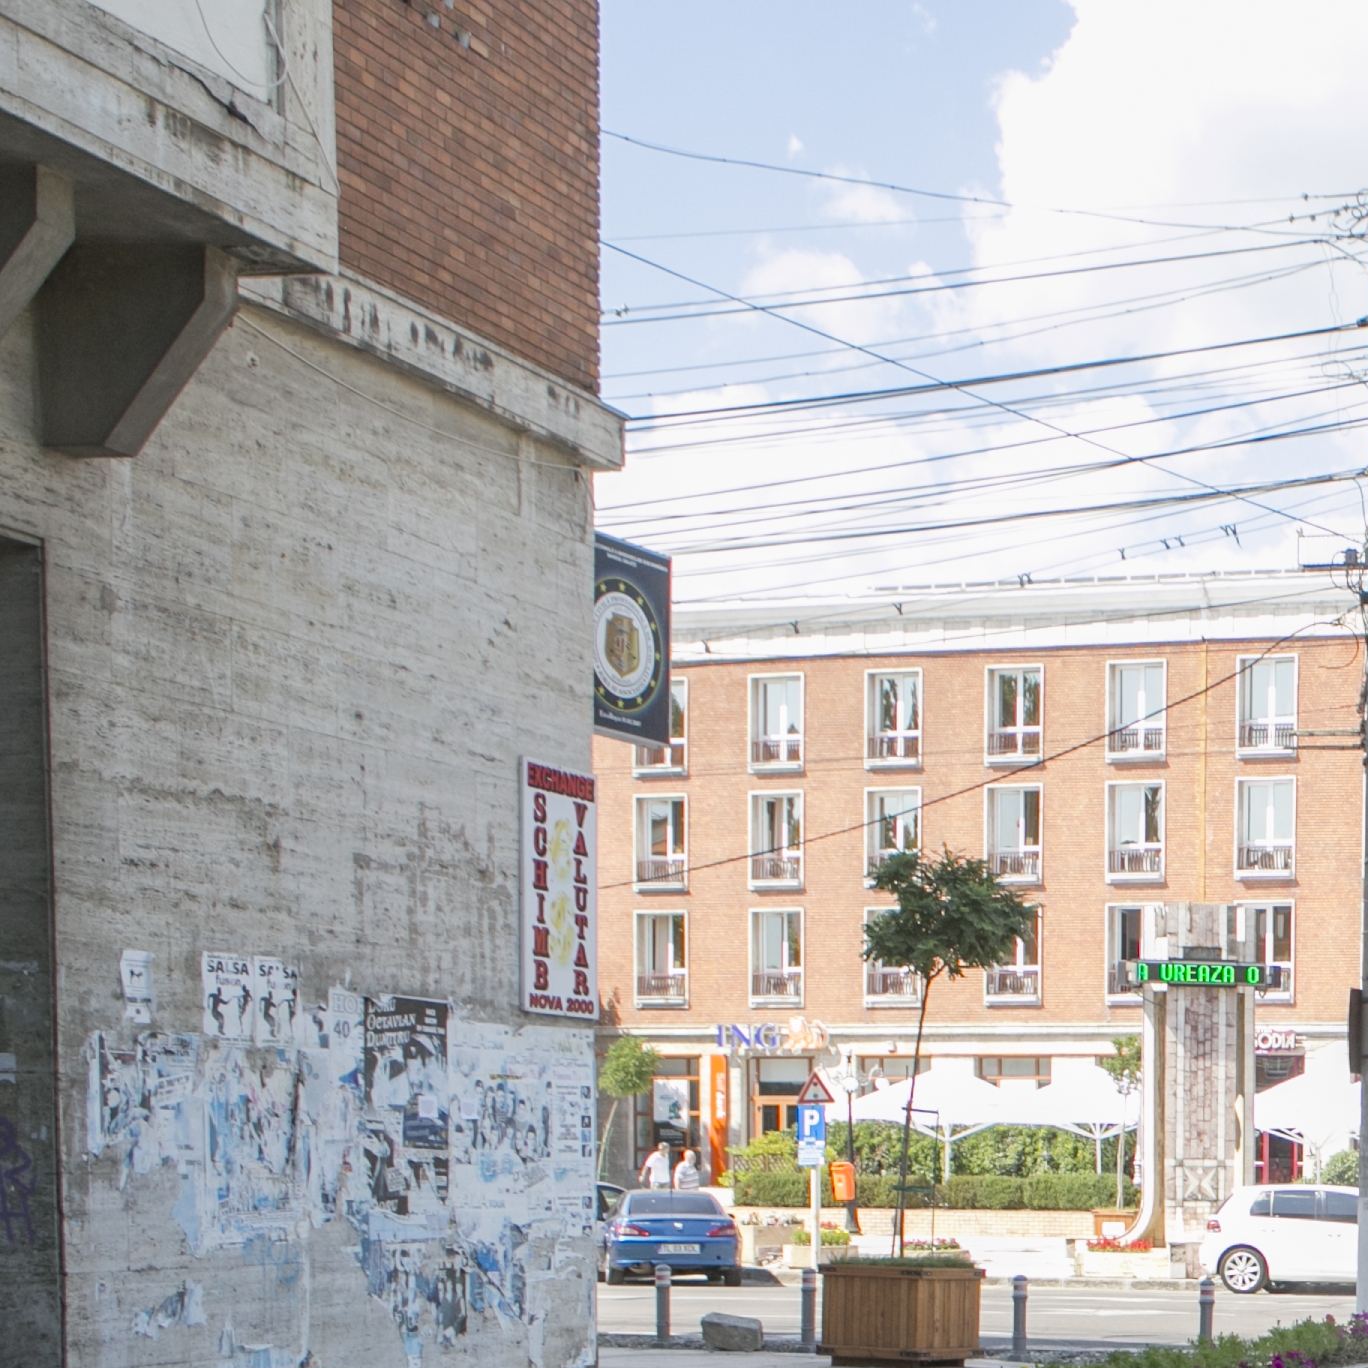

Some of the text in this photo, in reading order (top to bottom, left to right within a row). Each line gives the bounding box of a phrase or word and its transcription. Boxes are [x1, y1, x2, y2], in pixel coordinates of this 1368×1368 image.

[527, 762, 595, 803] EXCHANGE
[533, 792, 550, 991] SCHIMB
[573, 801, 590, 997] VALUTAR
[207, 960, 250, 976] SALSA
[1160, 964, 1235, 983] UREAZA
[529, 993, 594, 1015] NOVA 2000
[715, 1024, 780, 1049] ING
[803, 1109, 820, 1137] P
